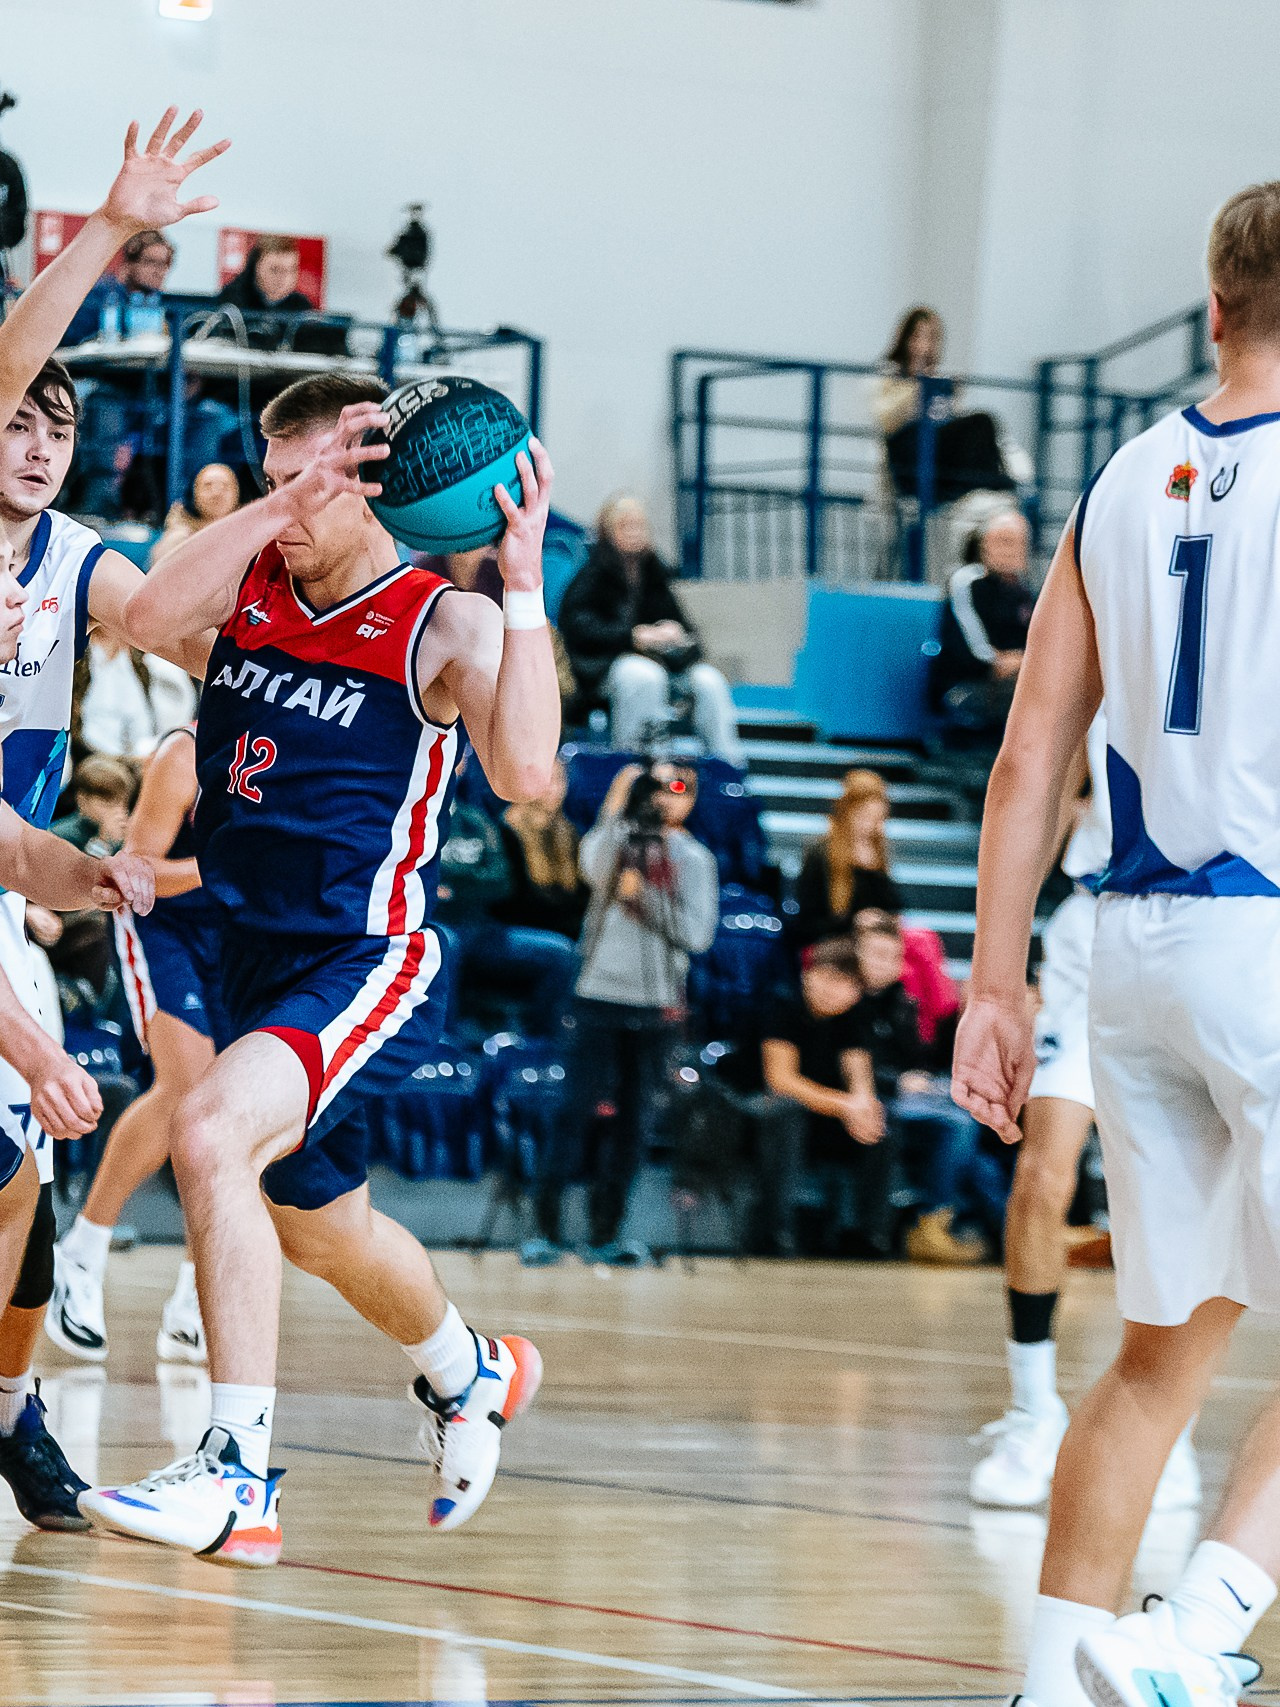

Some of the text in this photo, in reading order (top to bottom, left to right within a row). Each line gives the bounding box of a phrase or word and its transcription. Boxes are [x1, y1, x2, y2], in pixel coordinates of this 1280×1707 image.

[1164, 534, 1213, 735] 1
[210, 659, 366, 728] АЛТАЙ
[227, 730, 278, 804] 12
